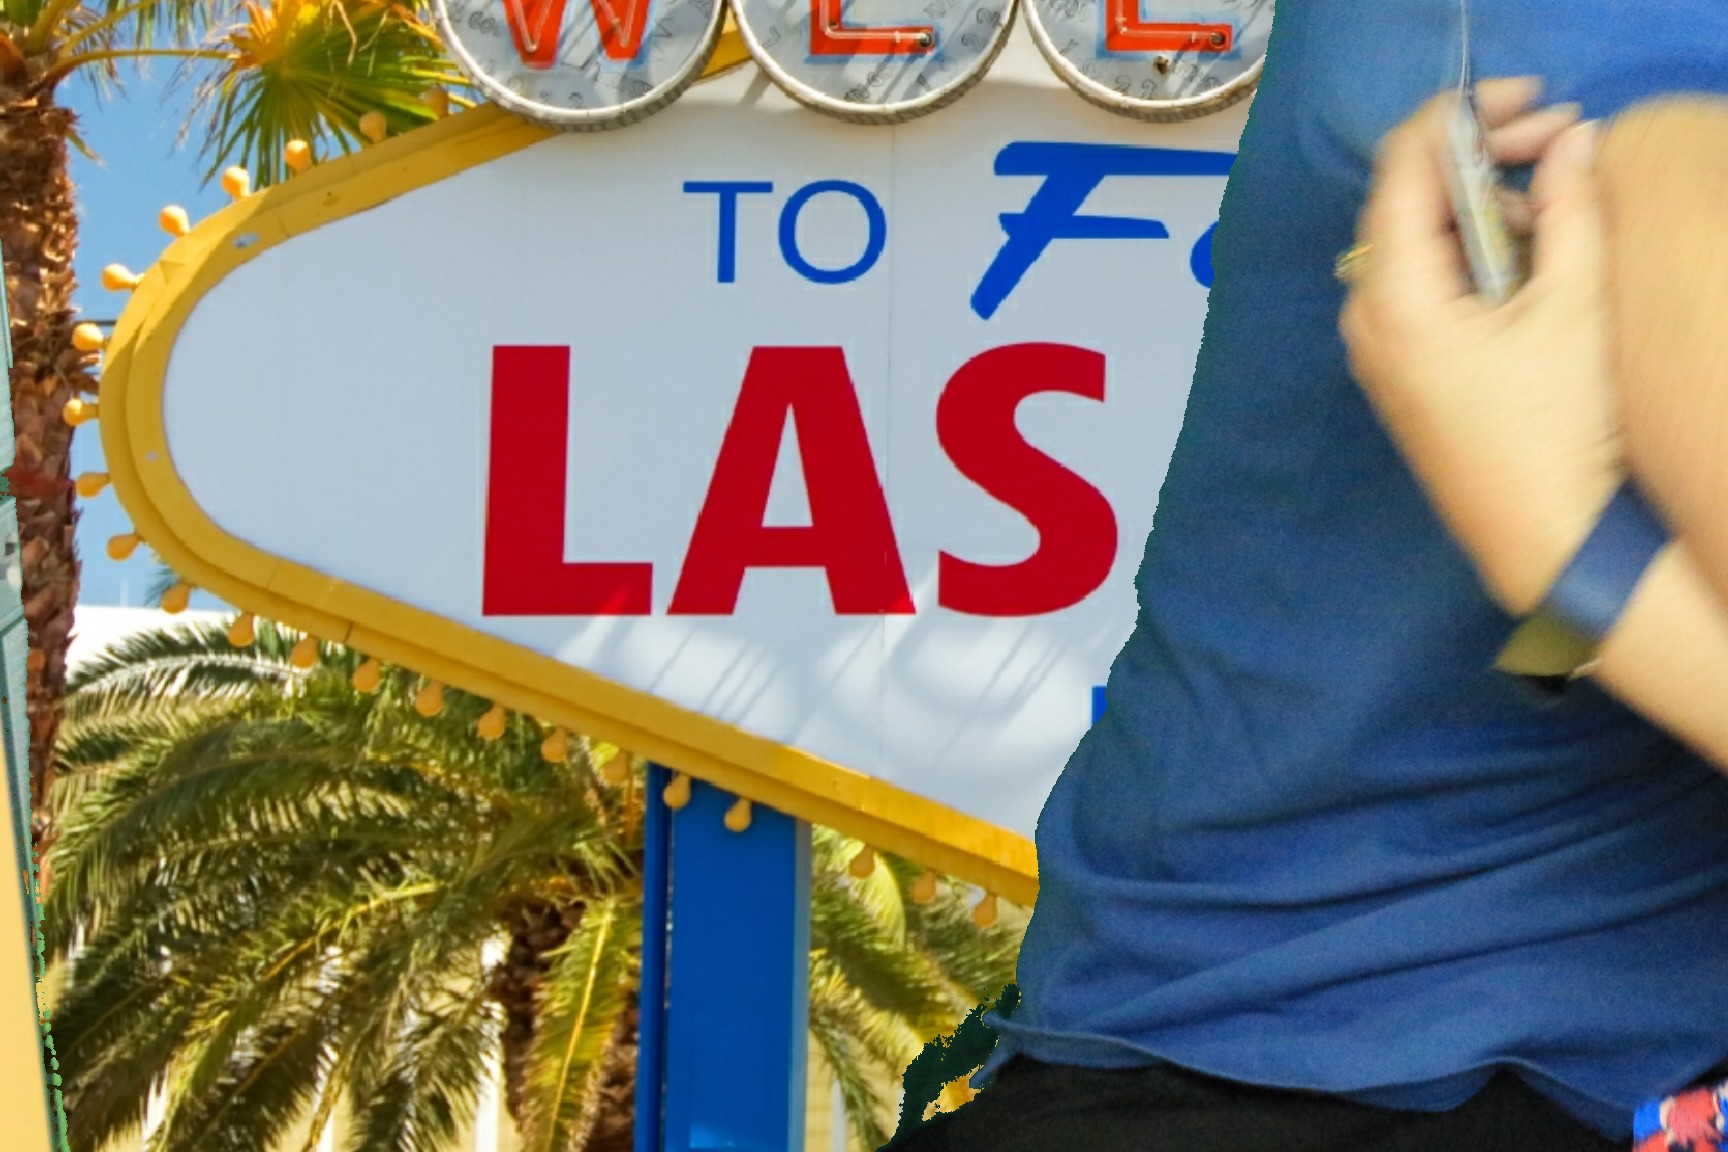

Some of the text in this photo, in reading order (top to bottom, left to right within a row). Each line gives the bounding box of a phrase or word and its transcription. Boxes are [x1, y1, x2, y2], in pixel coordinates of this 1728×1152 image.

[683, 141, 1238, 321] TO F
[482, 342, 1118, 617] LAS
